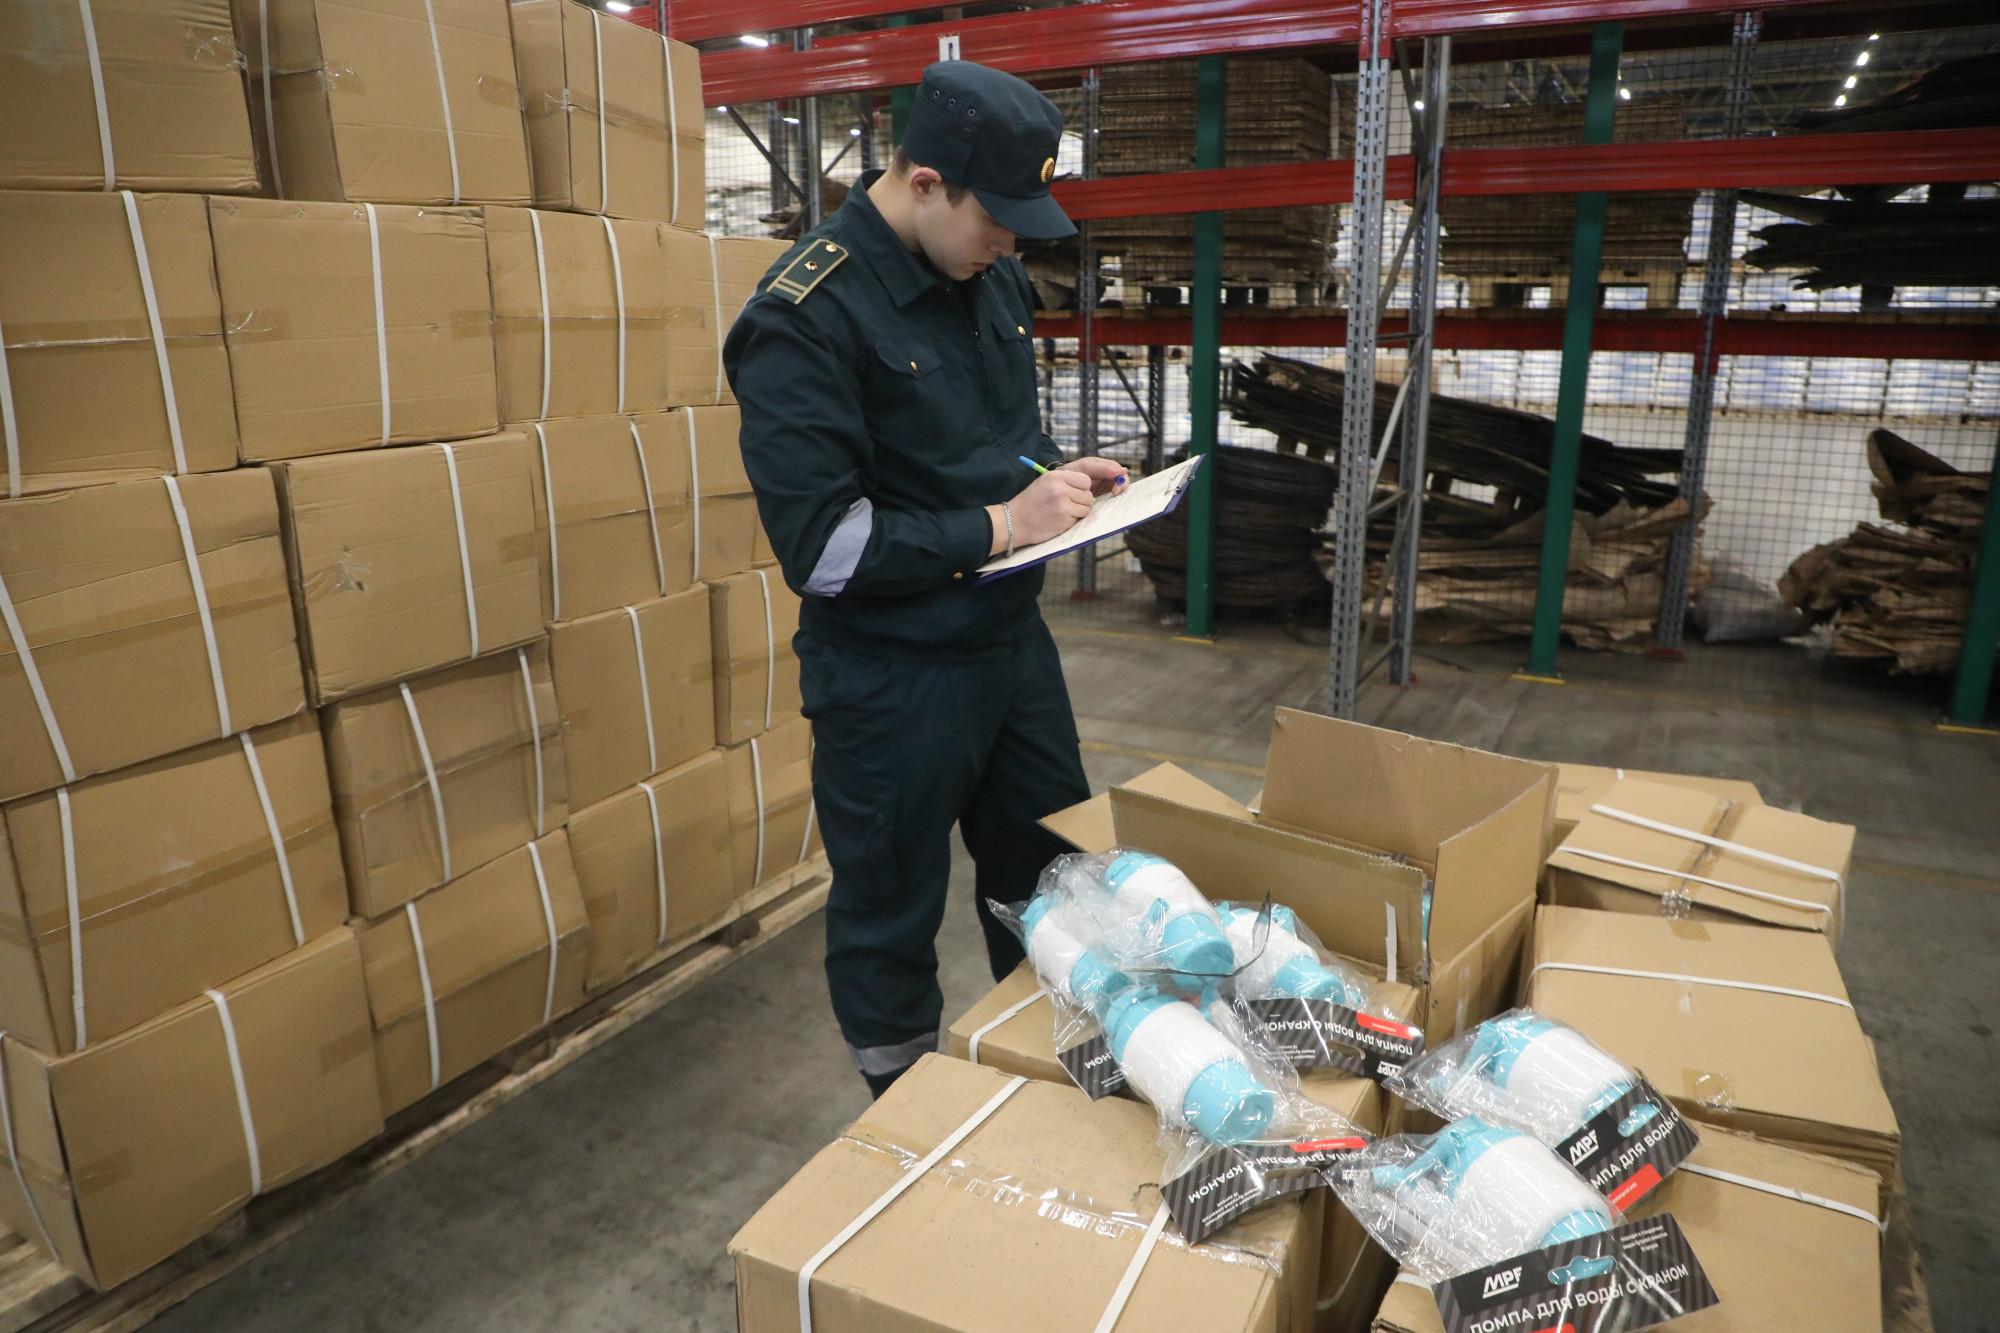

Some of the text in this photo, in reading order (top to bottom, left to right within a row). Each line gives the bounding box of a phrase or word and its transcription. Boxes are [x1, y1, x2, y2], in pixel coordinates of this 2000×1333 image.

[1314, 1021, 1322, 1030] С
[1325, 1020, 1354, 1038] ВОДЫ
[1355, 1031, 1376, 1045] ДЛЯ
[1376, 1038, 1413, 1056] ПОМПА
[1084, 1053, 1112, 1069] НОМ
[1590, 1165, 1622, 1190] МПА
[1619, 1141, 1646, 1170] ДЛЯ
[1644, 1116, 1675, 1148] ВОДЫ
[1188, 1164, 1244, 1204] КРАНОМ
[1470, 1263, 1689, 1333] ПОМПА ДЛЯ ВОДЫ С КРАНОМ
